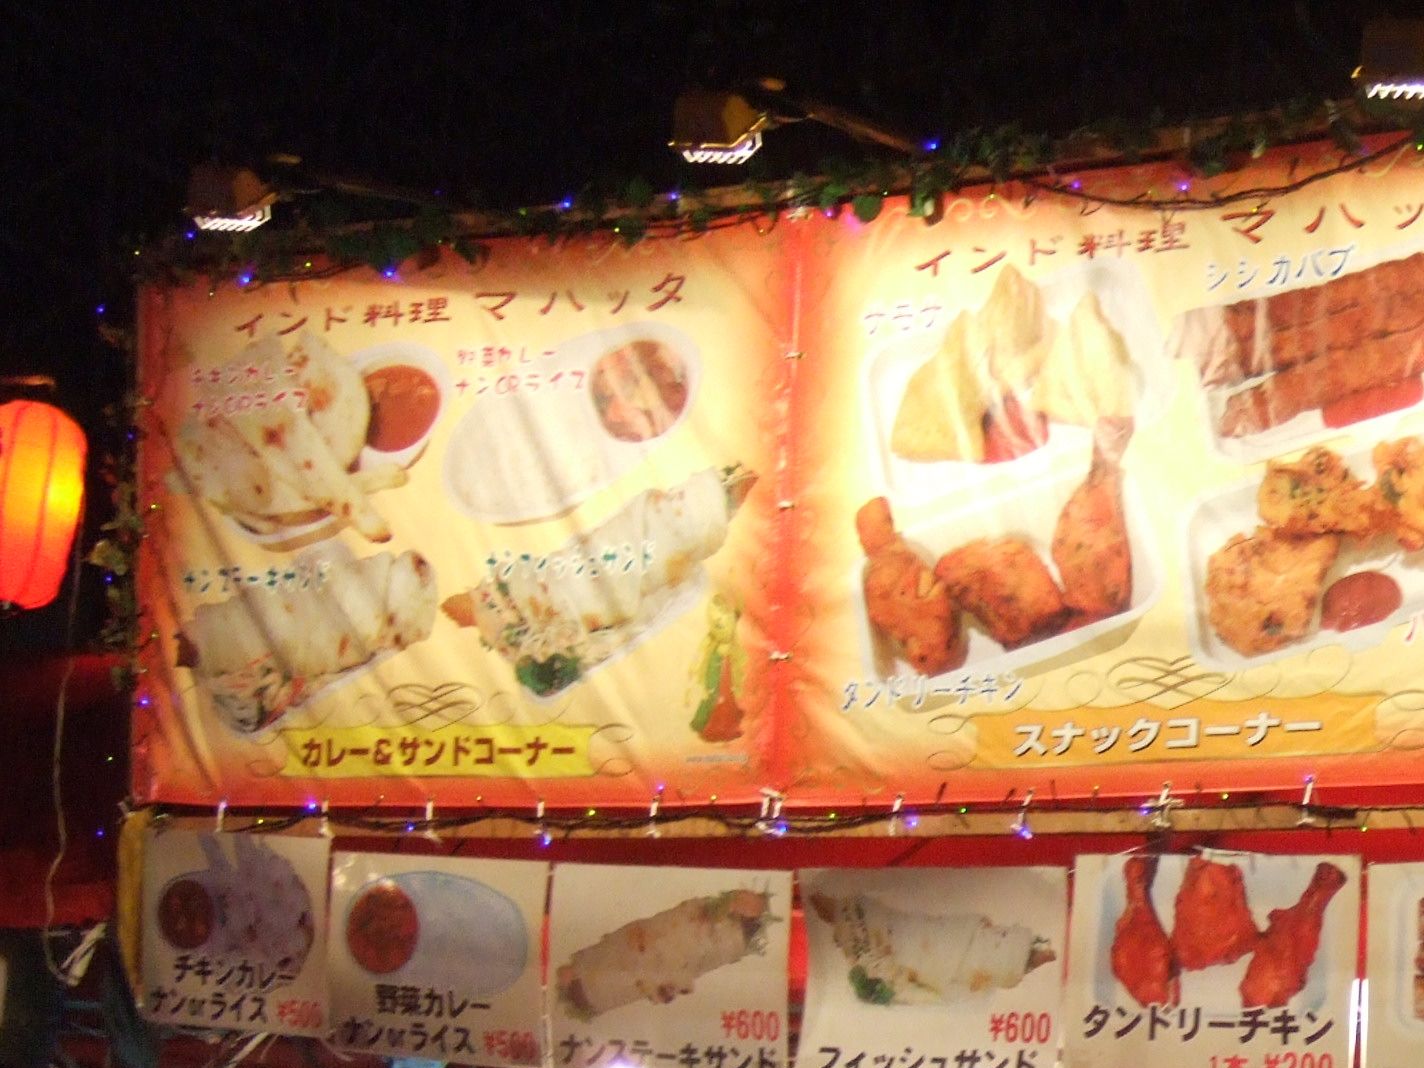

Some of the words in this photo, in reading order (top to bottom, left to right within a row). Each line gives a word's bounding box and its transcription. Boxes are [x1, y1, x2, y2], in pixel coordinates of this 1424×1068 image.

[915, 221, 1190, 277] インド料理
[234, 297, 451, 338] インド料理
[475, 273, 687, 321] マハッタ
[1012, 711, 1324, 757] スナックコーナー
[173, 955, 297, 989] チキンカレー
[375, 983, 491, 1019] 野菜カレー
[721, 1009, 780, 1042] ¥600
[988, 1011, 1052, 1044] ¥600
[1082, 1004, 1335, 1046] タンドリーチキン
